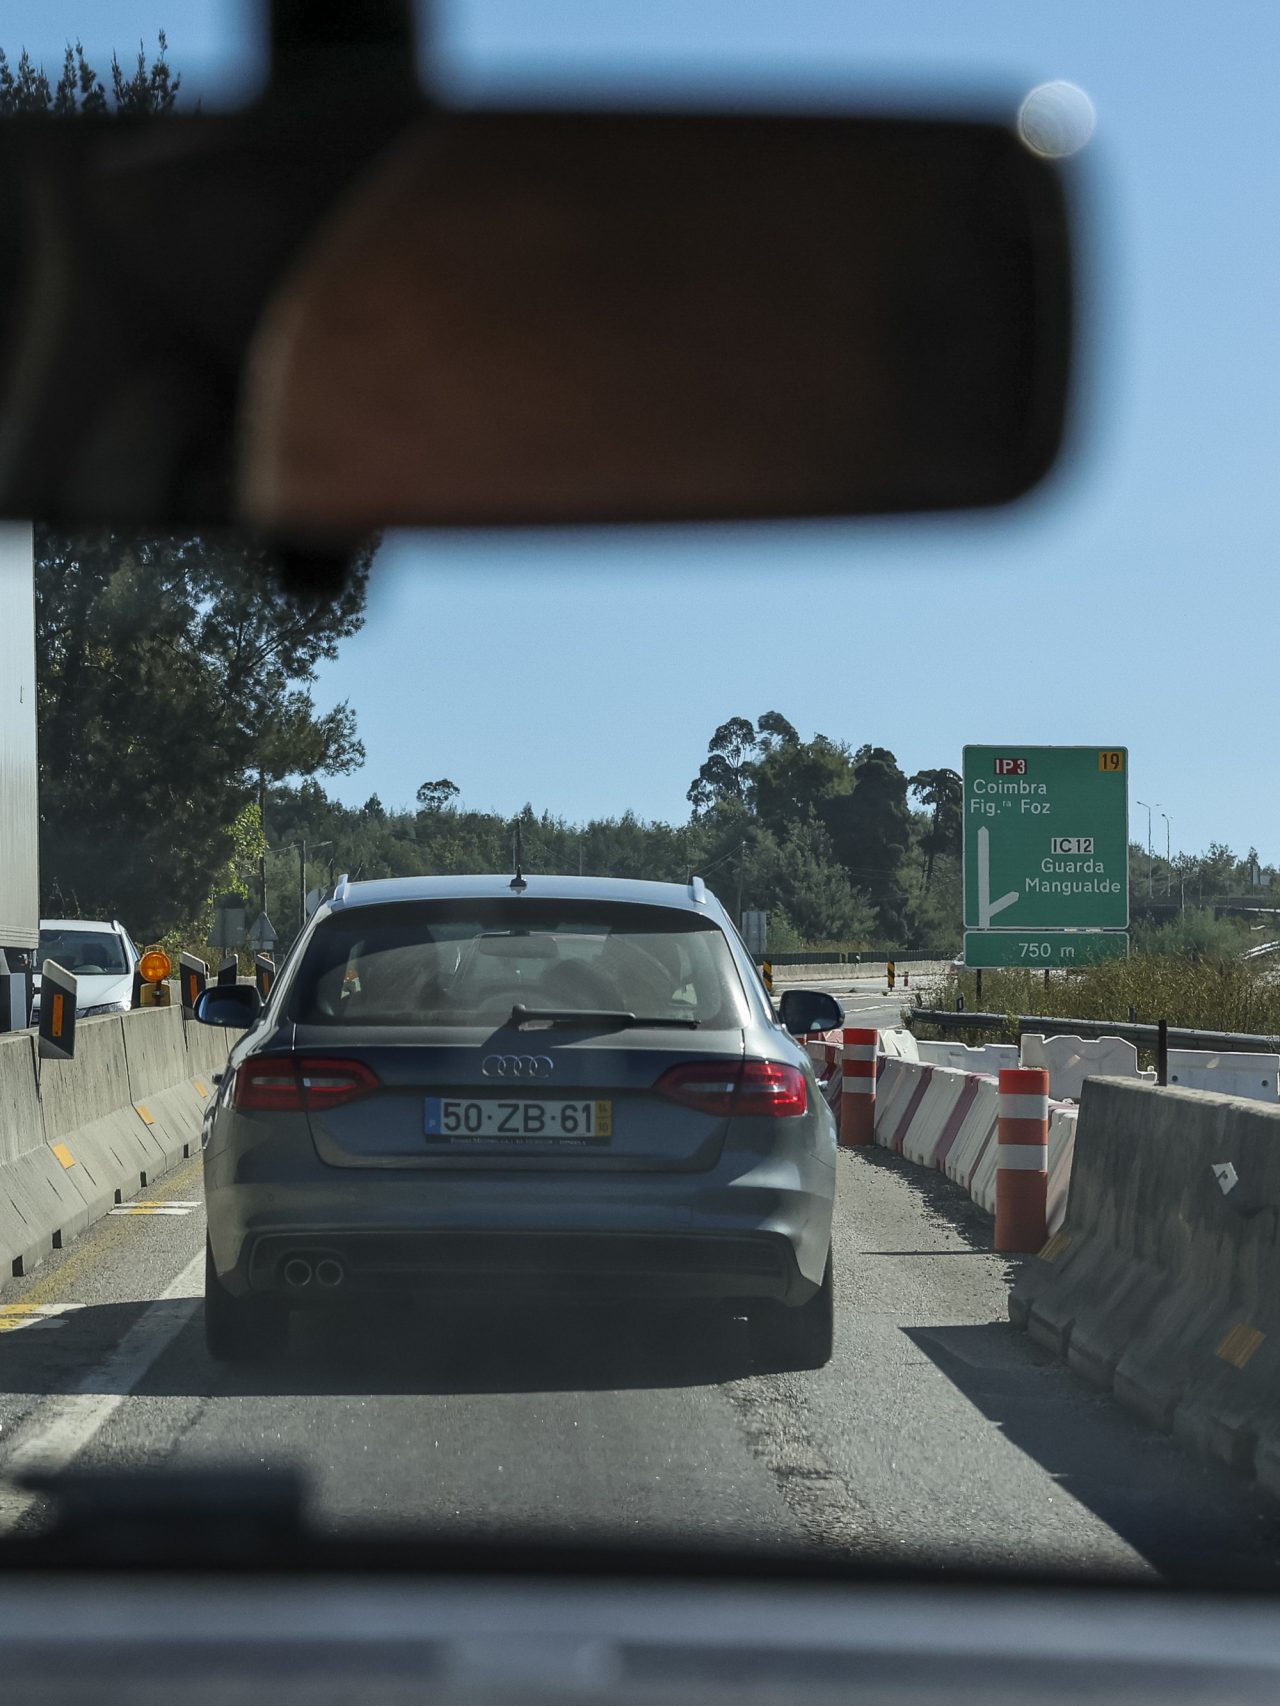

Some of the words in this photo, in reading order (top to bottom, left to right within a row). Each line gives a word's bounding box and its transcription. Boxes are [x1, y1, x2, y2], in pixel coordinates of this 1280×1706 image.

[1101, 752, 1120, 770] 19
[973, 779, 1047, 795] Coimbra
[1020, 800, 1051, 814] Foz
[1041, 858, 1104, 873] Guarda
[1025, 878, 1121, 895] Mangualde
[1018, 943, 1051, 958] 750
[1060, 947, 1075, 958] m
